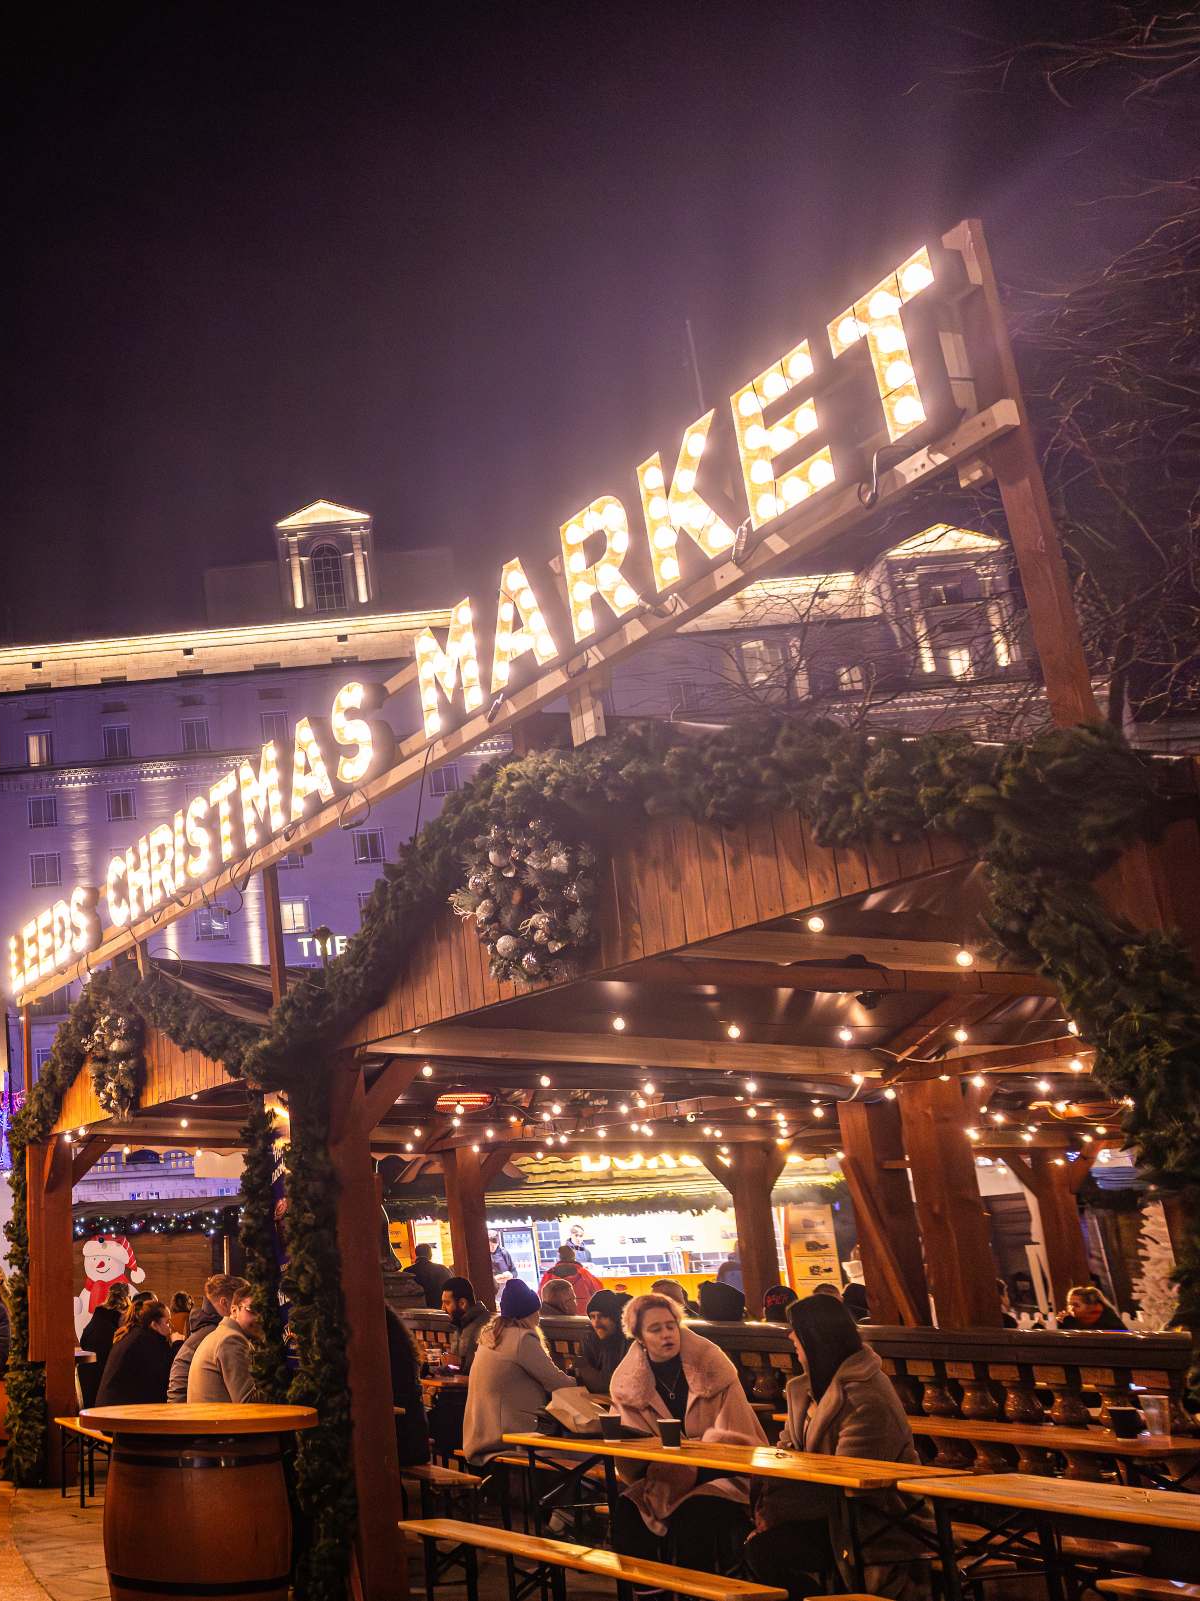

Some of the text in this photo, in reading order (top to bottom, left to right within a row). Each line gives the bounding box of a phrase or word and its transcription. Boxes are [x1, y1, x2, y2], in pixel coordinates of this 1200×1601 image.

[9, 245, 935, 994] LEEDS CHRISTMAS MARKET
